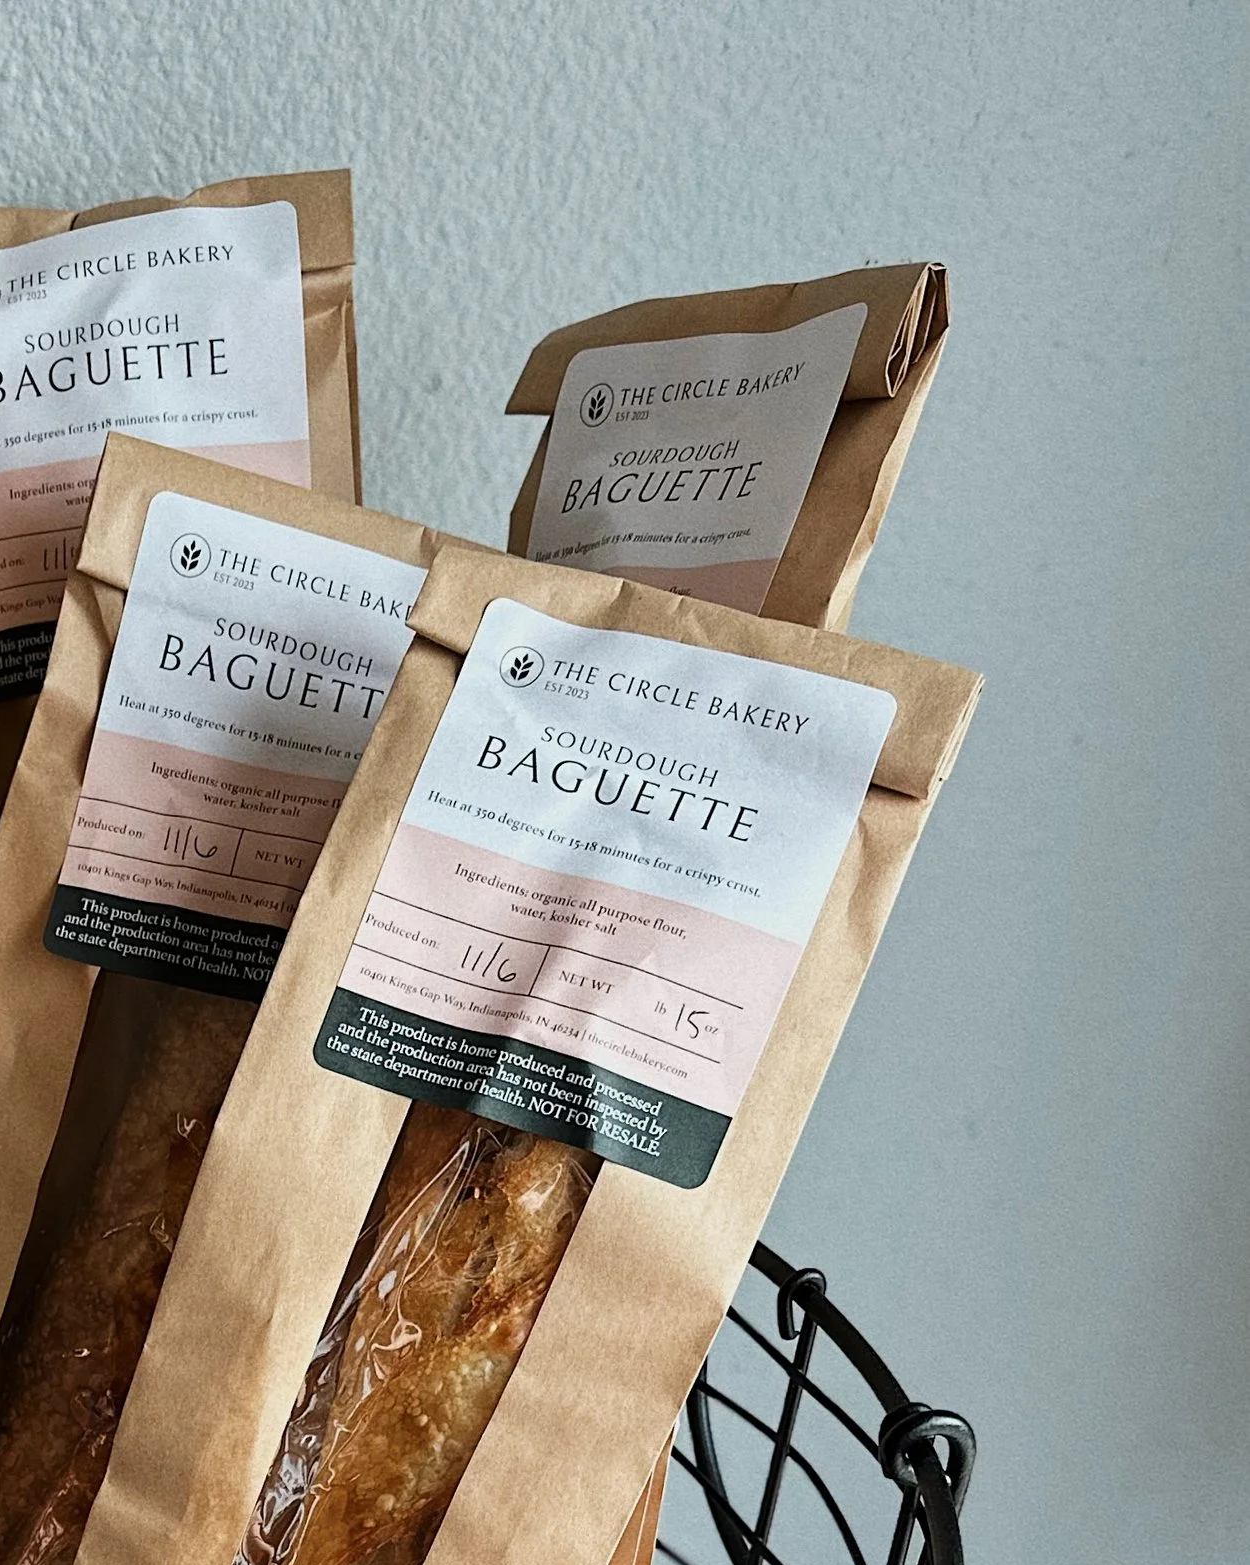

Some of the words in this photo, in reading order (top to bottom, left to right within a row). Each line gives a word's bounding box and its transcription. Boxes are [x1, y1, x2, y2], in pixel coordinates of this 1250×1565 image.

[7, 270, 46, 292] THE
[56, 253, 135, 280] CIRCLE
[147, 245, 233, 267] BAKERY
[25, 289, 47, 301] 2023
[24, 313, 178, 353] SOURDOUGH
[621, 386, 656, 406] THE
[661, 378, 729, 402] CIRCLE
[735, 361, 805, 395] BAKERY
[3, 435, 21, 448] 350
[23, 429, 65, 443] degrees
[68, 423, 83, 435] for
[87, 417, 111, 432] 15-18
[114, 415, 159, 426] minutes
[162, 411, 178, 422] for
[190, 410, 224, 423] crispy
[226, 409, 258, 419] crust.
[608, 439, 740, 467] SOURDOUGH
[560, 460, 762, 514] BAGUETTE
[213, 572, 231, 584] EST
[232, 576, 254, 591] 2023
[220, 549, 260, 576] THE
[270, 564, 349, 602] CIRCLE
[213, 617, 373, 677] SOURDOUGH
[159, 633, 384, 719] BAGUETT
[543, 680, 563, 693] EST
[564, 685, 589, 700] 2023
[553, 660, 599, 684] THE
[608, 672, 699, 710] CIRCLE
[707, 696, 809, 734] BAKERY
[540, 726, 718, 787] SOURDOUGH
[476, 735, 758, 841] BAGUETTE
[163, 825, 218, 860] 11/6
[427, 790, 457, 808] Heat
[459, 803, 472, 812] at
[475, 807, 495, 819] 350
[497, 812, 544, 836] degrees
[547, 829, 565, 843] for
[568, 838, 598, 851] 15-18
[599, 845, 650, 864] minutes
[652, 856, 672, 871] for
[685, 869, 724, 886] crispy
[726, 880, 760, 897] crust.
[454, 863, 528, 897] Ingredients:
[530, 891, 577, 907] organic
[578, 899, 597, 911] all
[596, 905, 650, 926] purpose
[652, 917, 686, 939] flour,
[511, 903, 546, 921] water,
[548, 909, 591, 927] kosher
[595, 922, 616, 935] salt
[365, 912, 420, 941] Produced
[420, 937, 439, 949] on:
[460, 942, 517, 983] 11/6
[558, 970, 587, 987] NET
[591, 979, 613, 993] WT
[388, 975, 417, 993] Kings
[419, 986, 440, 1003] Gap
[444, 993, 465, 1010] Way,
[468, 1001, 532, 1023] Indianapolis,
[535, 1015, 550, 1027] IN
[550, 1023, 580, 1038] 46234
[587, 1033, 687, 1078] thecirclebakery.com
[654, 1000, 667, 1015] lb
[675, 1003, 710, 1039] 15
[704, 1024, 719, 1035] oz
[337, 1022, 366, 1040] and
[366, 1029, 389, 1048] the
[388, 1040, 464, 1070] production
[465, 1063, 494, 1077] area
[495, 1064, 521, 1085] has
[521, 1077, 547, 1093] not
[547, 1081, 582, 1105] been
[583, 1093, 649, 1131] inspected
[648, 1118, 668, 1139] by
[359, 1006, 389, 1029] This
[388, 1021, 445, 1047] product
[444, 1036, 457, 1050] is
[457, 1038, 496, 1057] home
[496, 1050, 566, 1079] produced
[565, 1072, 597, 1088] and
[592, 1080, 662, 1116] processed
[326, 1035, 350, 1053] the
[350, 1046, 383, 1065] state
[385, 1055, 462, 1088] department
[463, 1078, 481, 1091] of
[480, 1079, 525, 1107] health.
[528, 1095, 566, 1118] NOT
[565, 1108, 600, 1131] FOR
[600, 1121, 660, 1156] RESALE.
